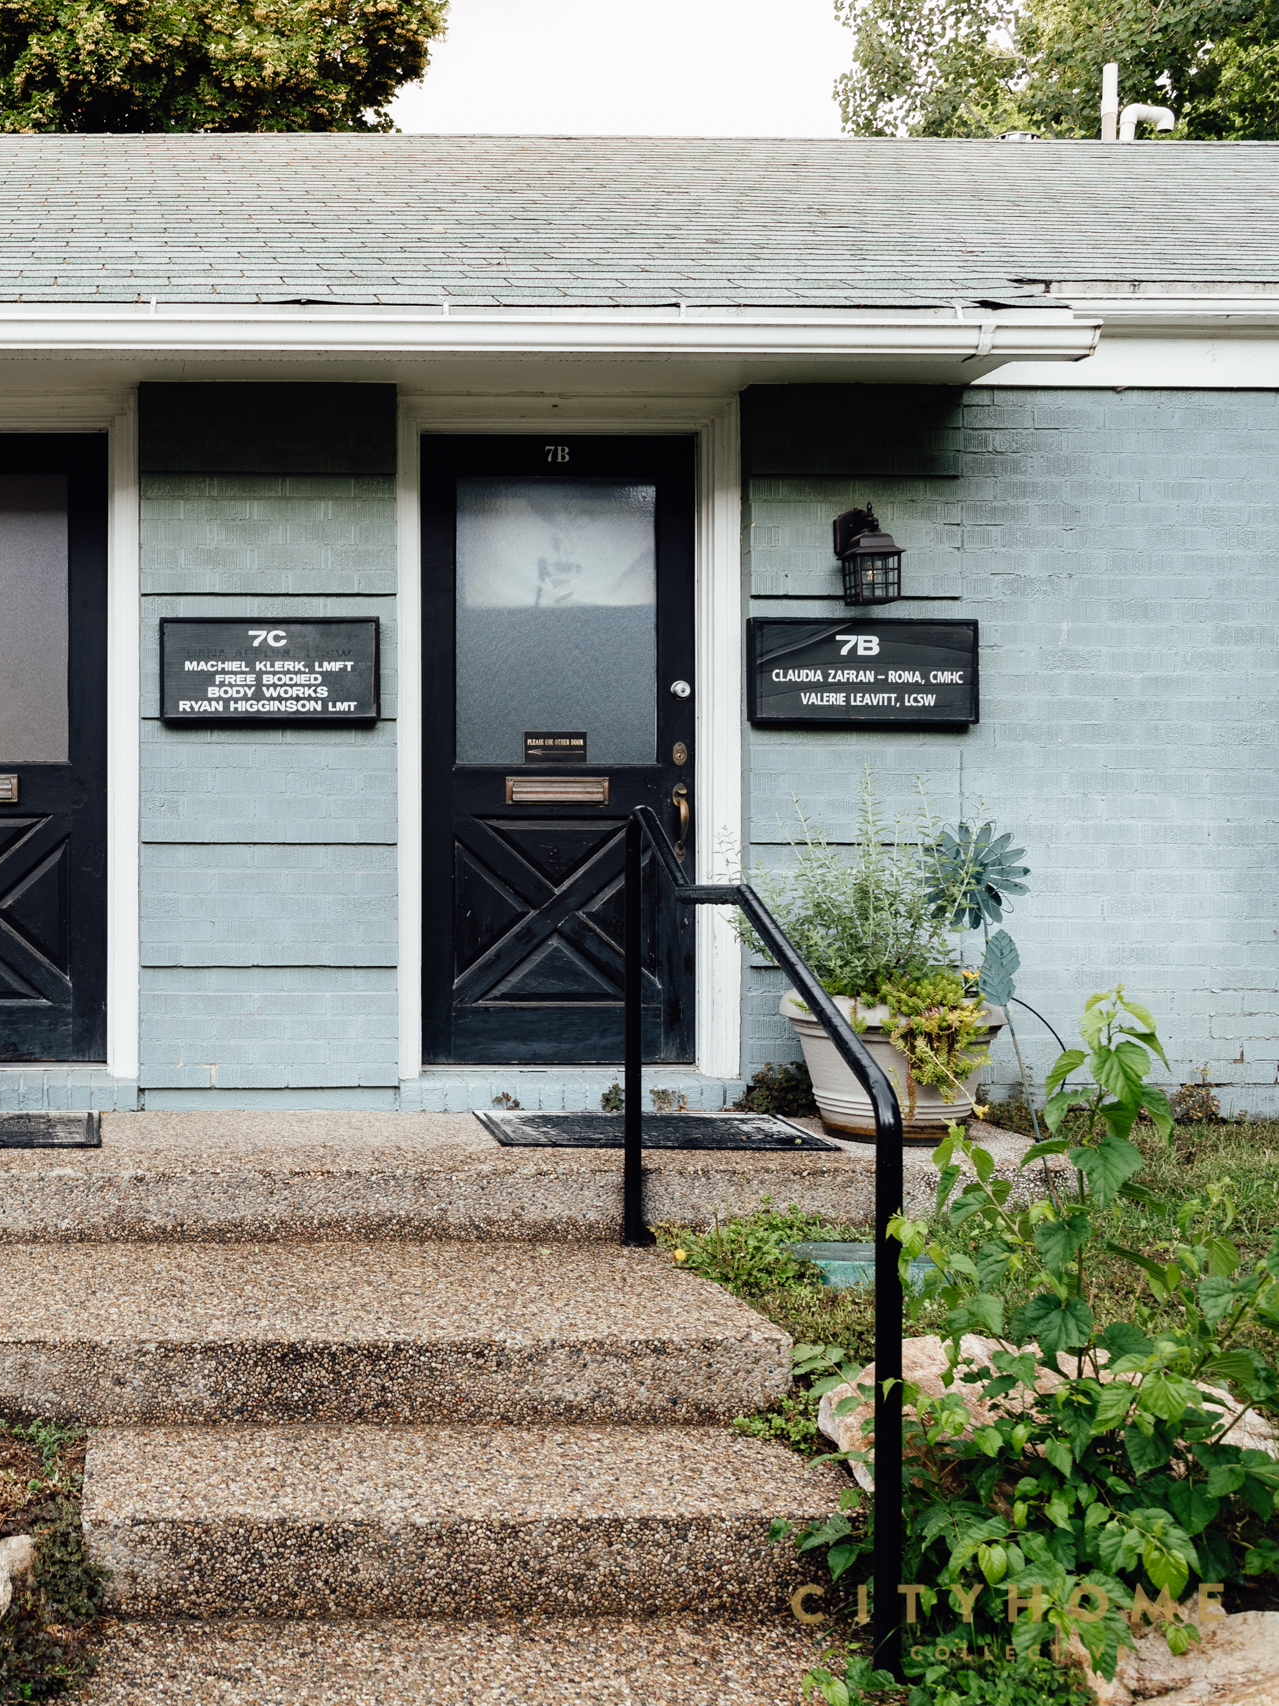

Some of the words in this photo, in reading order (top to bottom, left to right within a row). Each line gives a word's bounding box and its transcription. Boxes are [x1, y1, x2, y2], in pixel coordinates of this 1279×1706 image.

[544, 445, 570, 463] 7B
[248, 630, 288, 647] 7C
[835, 635, 880, 656] 7B
[184, 660, 250, 672] MACHIEL
[255, 661, 310, 673] KLERK,
[314, 661, 355, 672] LMFT
[215, 674, 257, 685] FREE
[262, 674, 323, 685] BODIED
[771, 669, 824, 683] CLAUDIA
[827, 670, 875, 683] ZAFRAN
[887, 671, 926, 685] RONA,
[929, 671, 964, 684] CMHC
[207, 686, 256, 698] BODY
[263, 686, 329, 698] WORKS
[178, 700, 224, 712] RYAN
[229, 700, 322, 712] HIGGINSON
[328, 701, 358, 712] LMT
[800, 692, 847, 706] VALERIE
[850, 693, 900, 707] LEAVITT,
[904, 694, 937, 707] LCSW
[527, 738, 544, 746] PLEASE
[544, 738, 554, 746] USE
[554, 738, 570, 746] OTHER
[570, 738, 584, 746] DOOR
